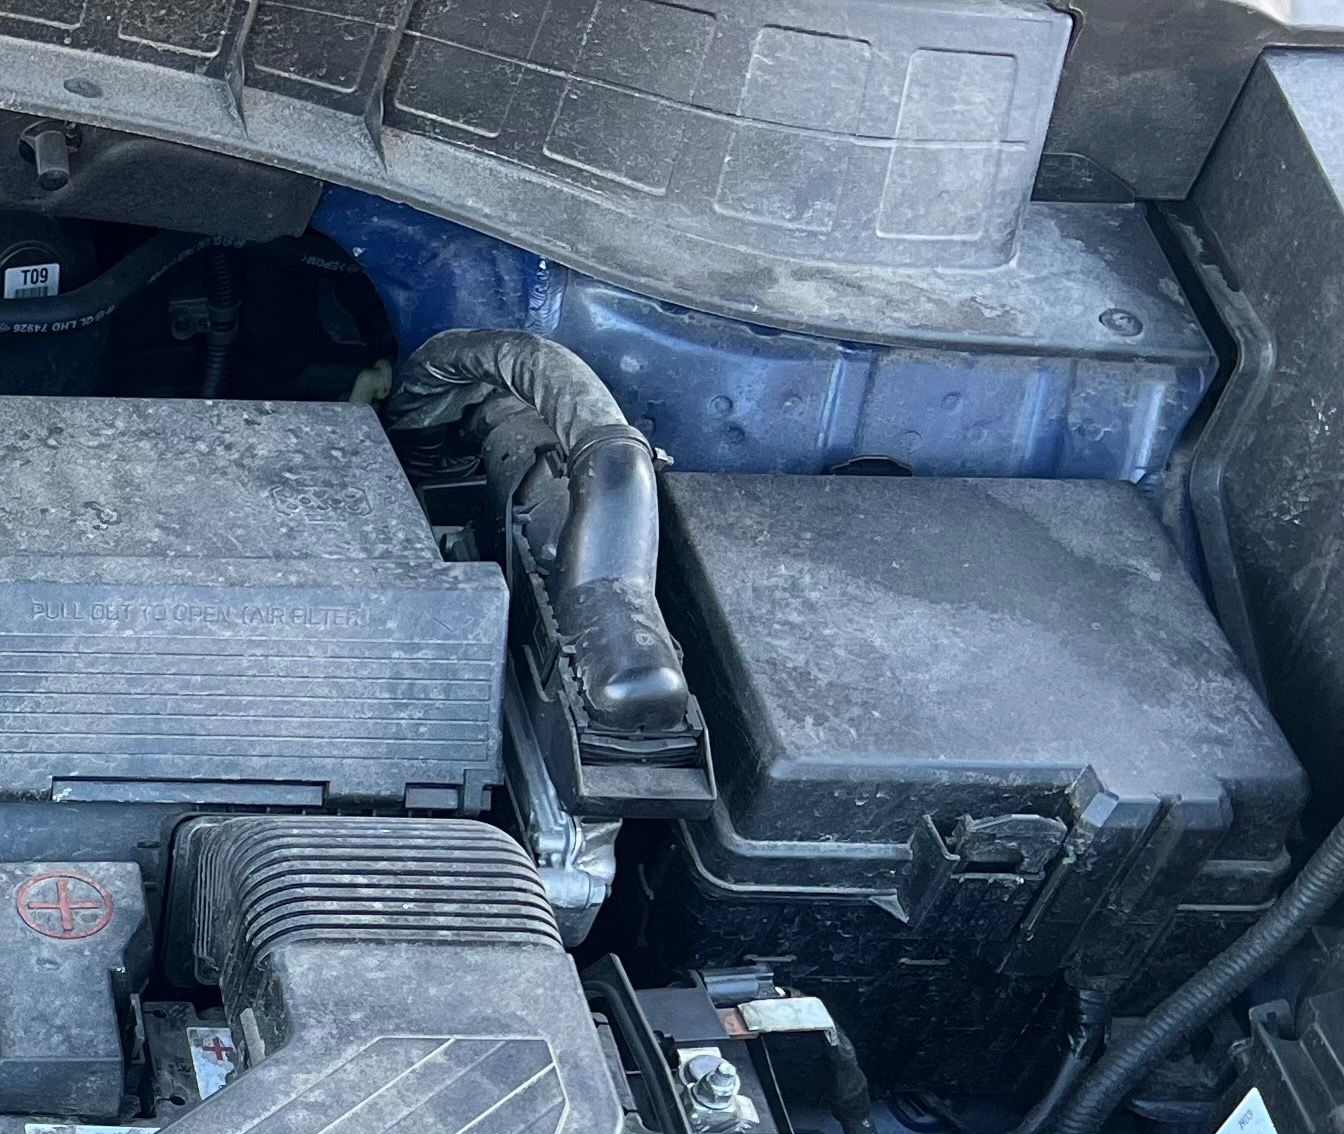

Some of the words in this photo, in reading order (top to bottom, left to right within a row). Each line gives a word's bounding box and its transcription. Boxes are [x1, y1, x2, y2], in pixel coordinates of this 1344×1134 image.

[21, 268, 49, 286] T09
[30, 601, 84, 621] PULL
[90, 602, 132, 621] OUT
[137, 603, 166, 622] TO
[173, 603, 229, 623] OPEN
